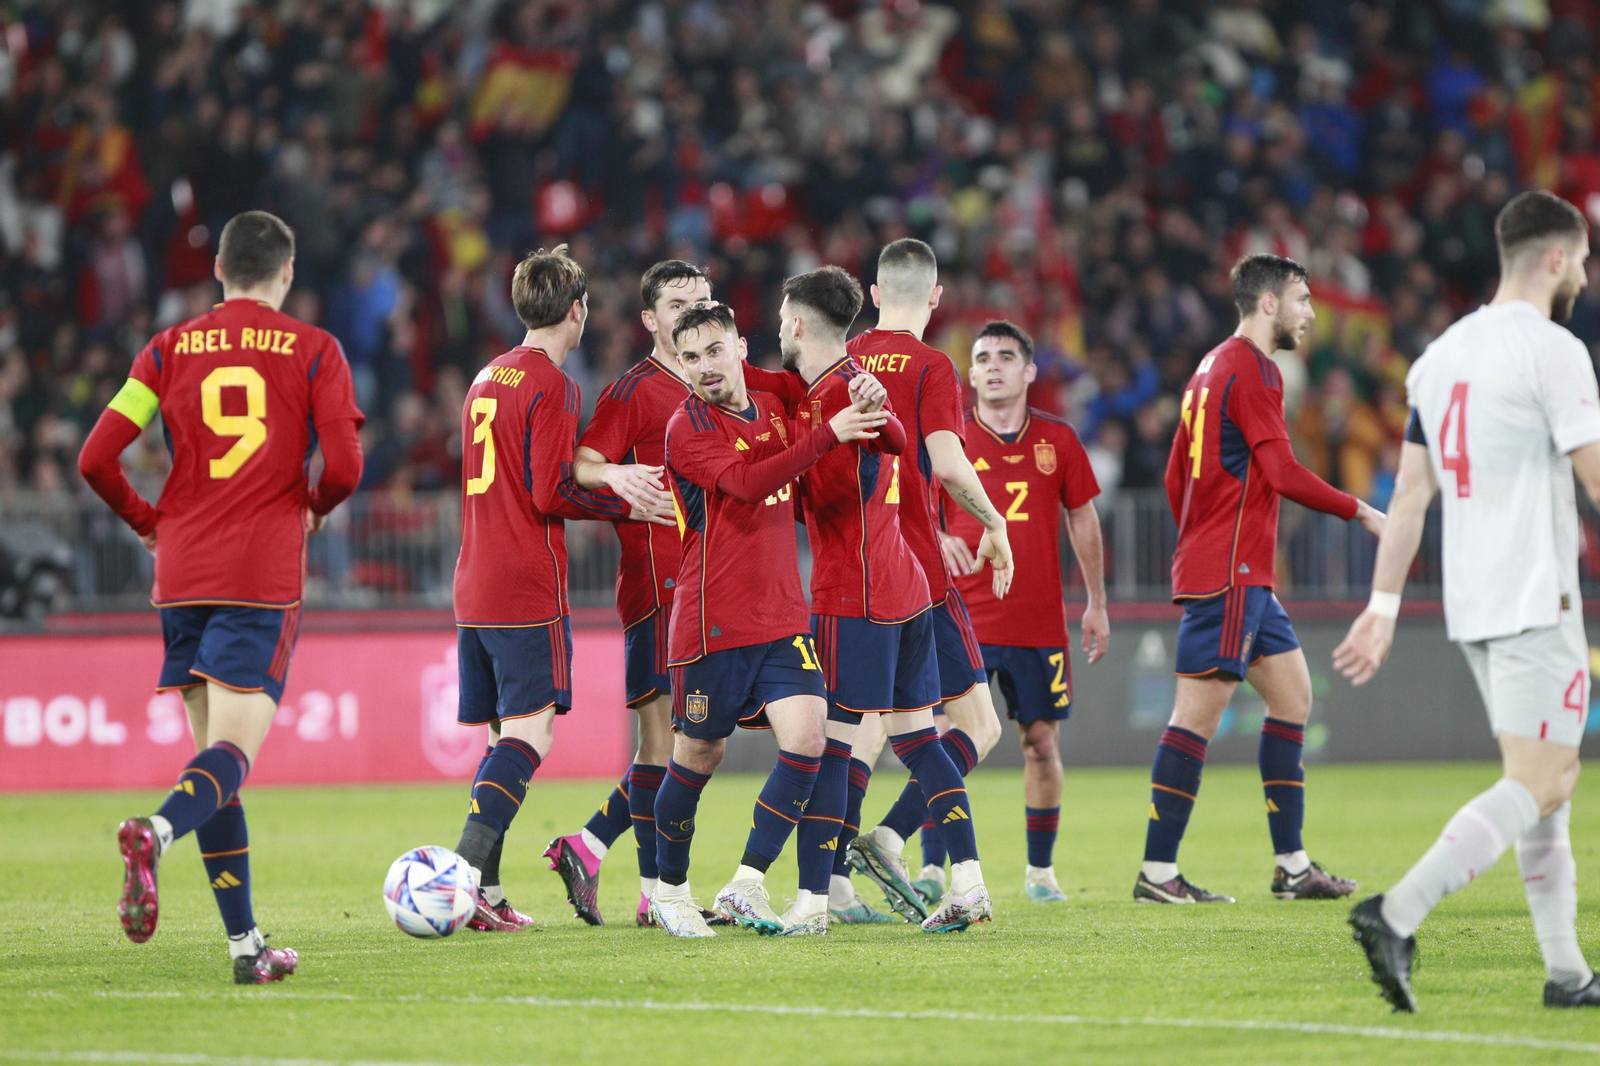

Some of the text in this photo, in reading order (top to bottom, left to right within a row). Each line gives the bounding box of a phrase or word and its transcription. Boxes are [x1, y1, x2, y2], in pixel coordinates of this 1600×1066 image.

[174, 327, 297, 355] ABEL RUIZ
[200, 365, 267, 479] 9
[466, 397, 498, 496] 3
[1439, 381, 1471, 498] 4
[1005, 481, 1029, 521] 2
[1048, 651, 1067, 693] 2
[1564, 669, 1584, 724] 4
[0, 694, 127, 747] BOL
